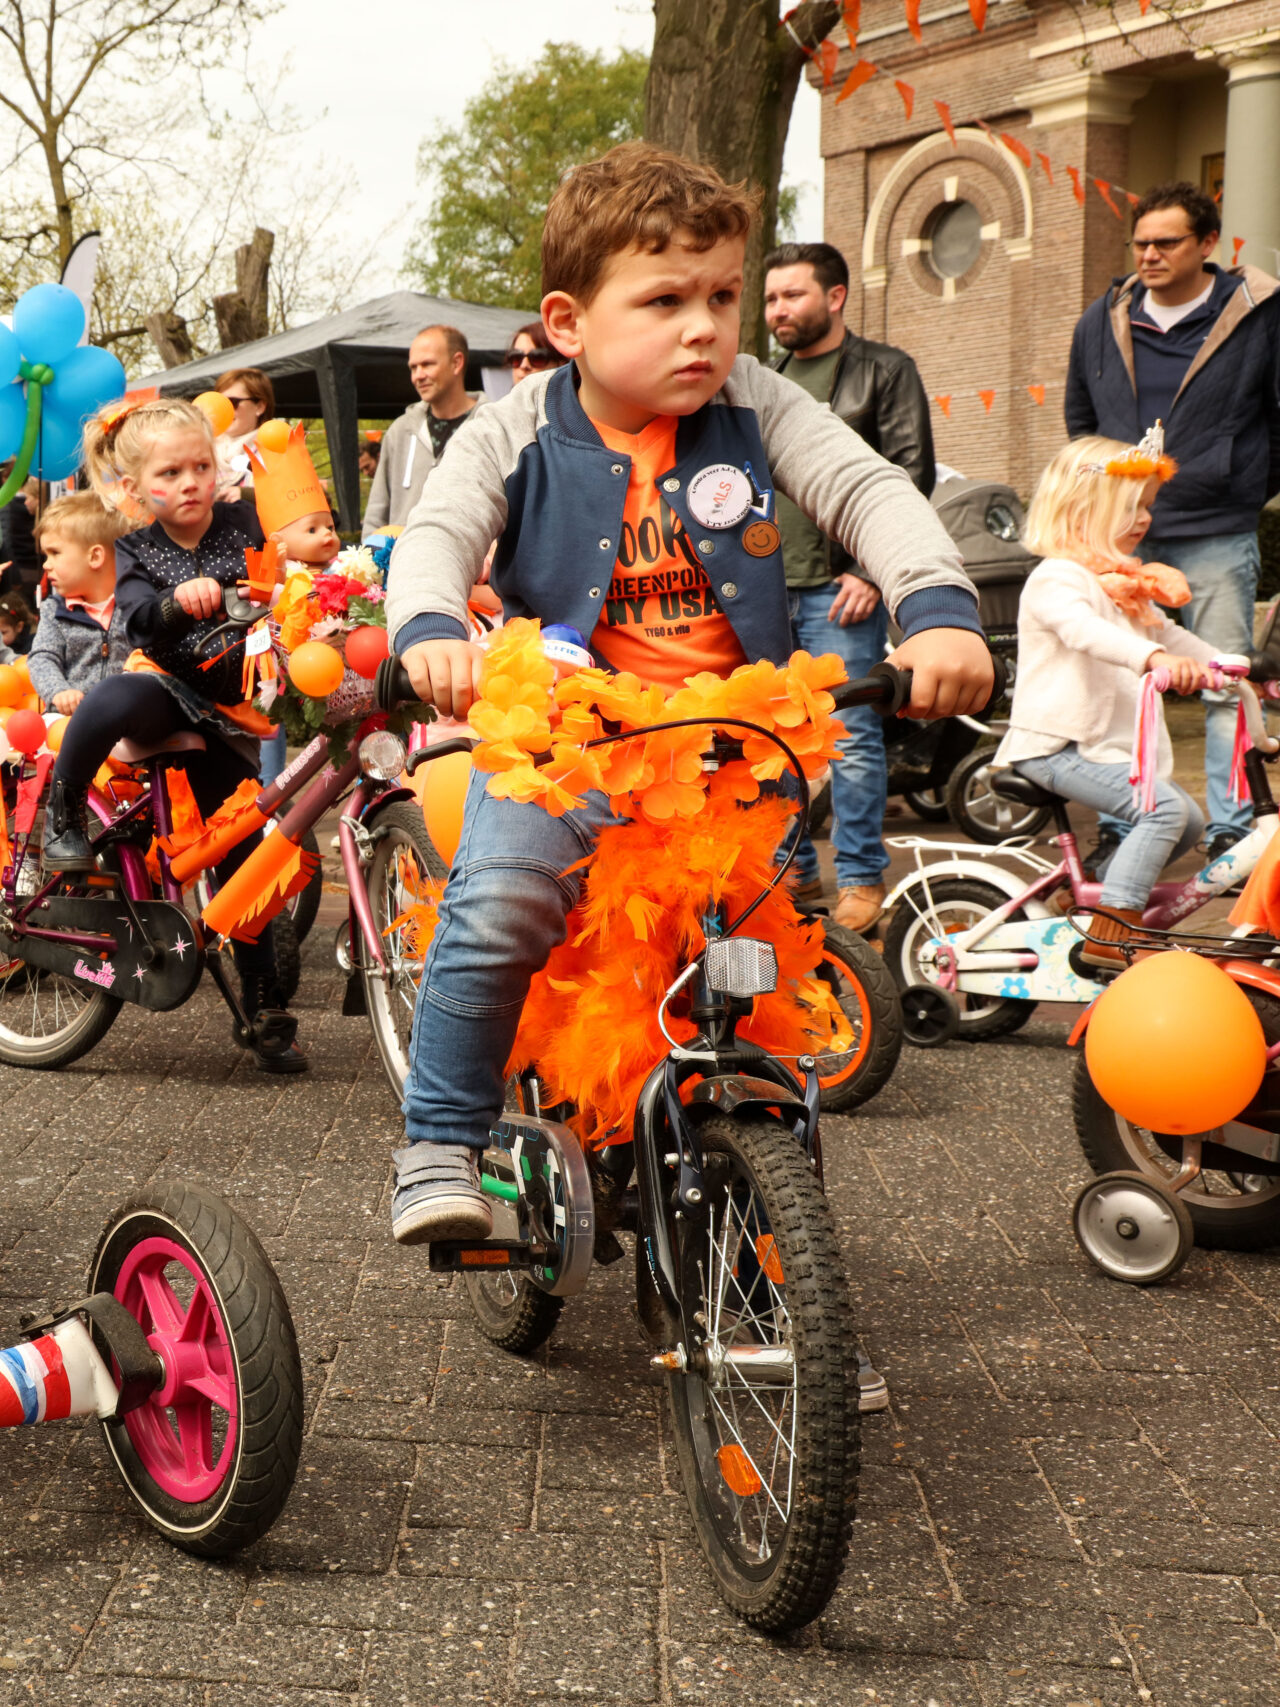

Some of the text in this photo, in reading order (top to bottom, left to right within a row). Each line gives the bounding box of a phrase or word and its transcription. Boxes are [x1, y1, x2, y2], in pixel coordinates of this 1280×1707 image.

[659, 587, 726, 621] USA
[644, 627, 666, 638] TYGO
[667, 627, 674, 636] &
